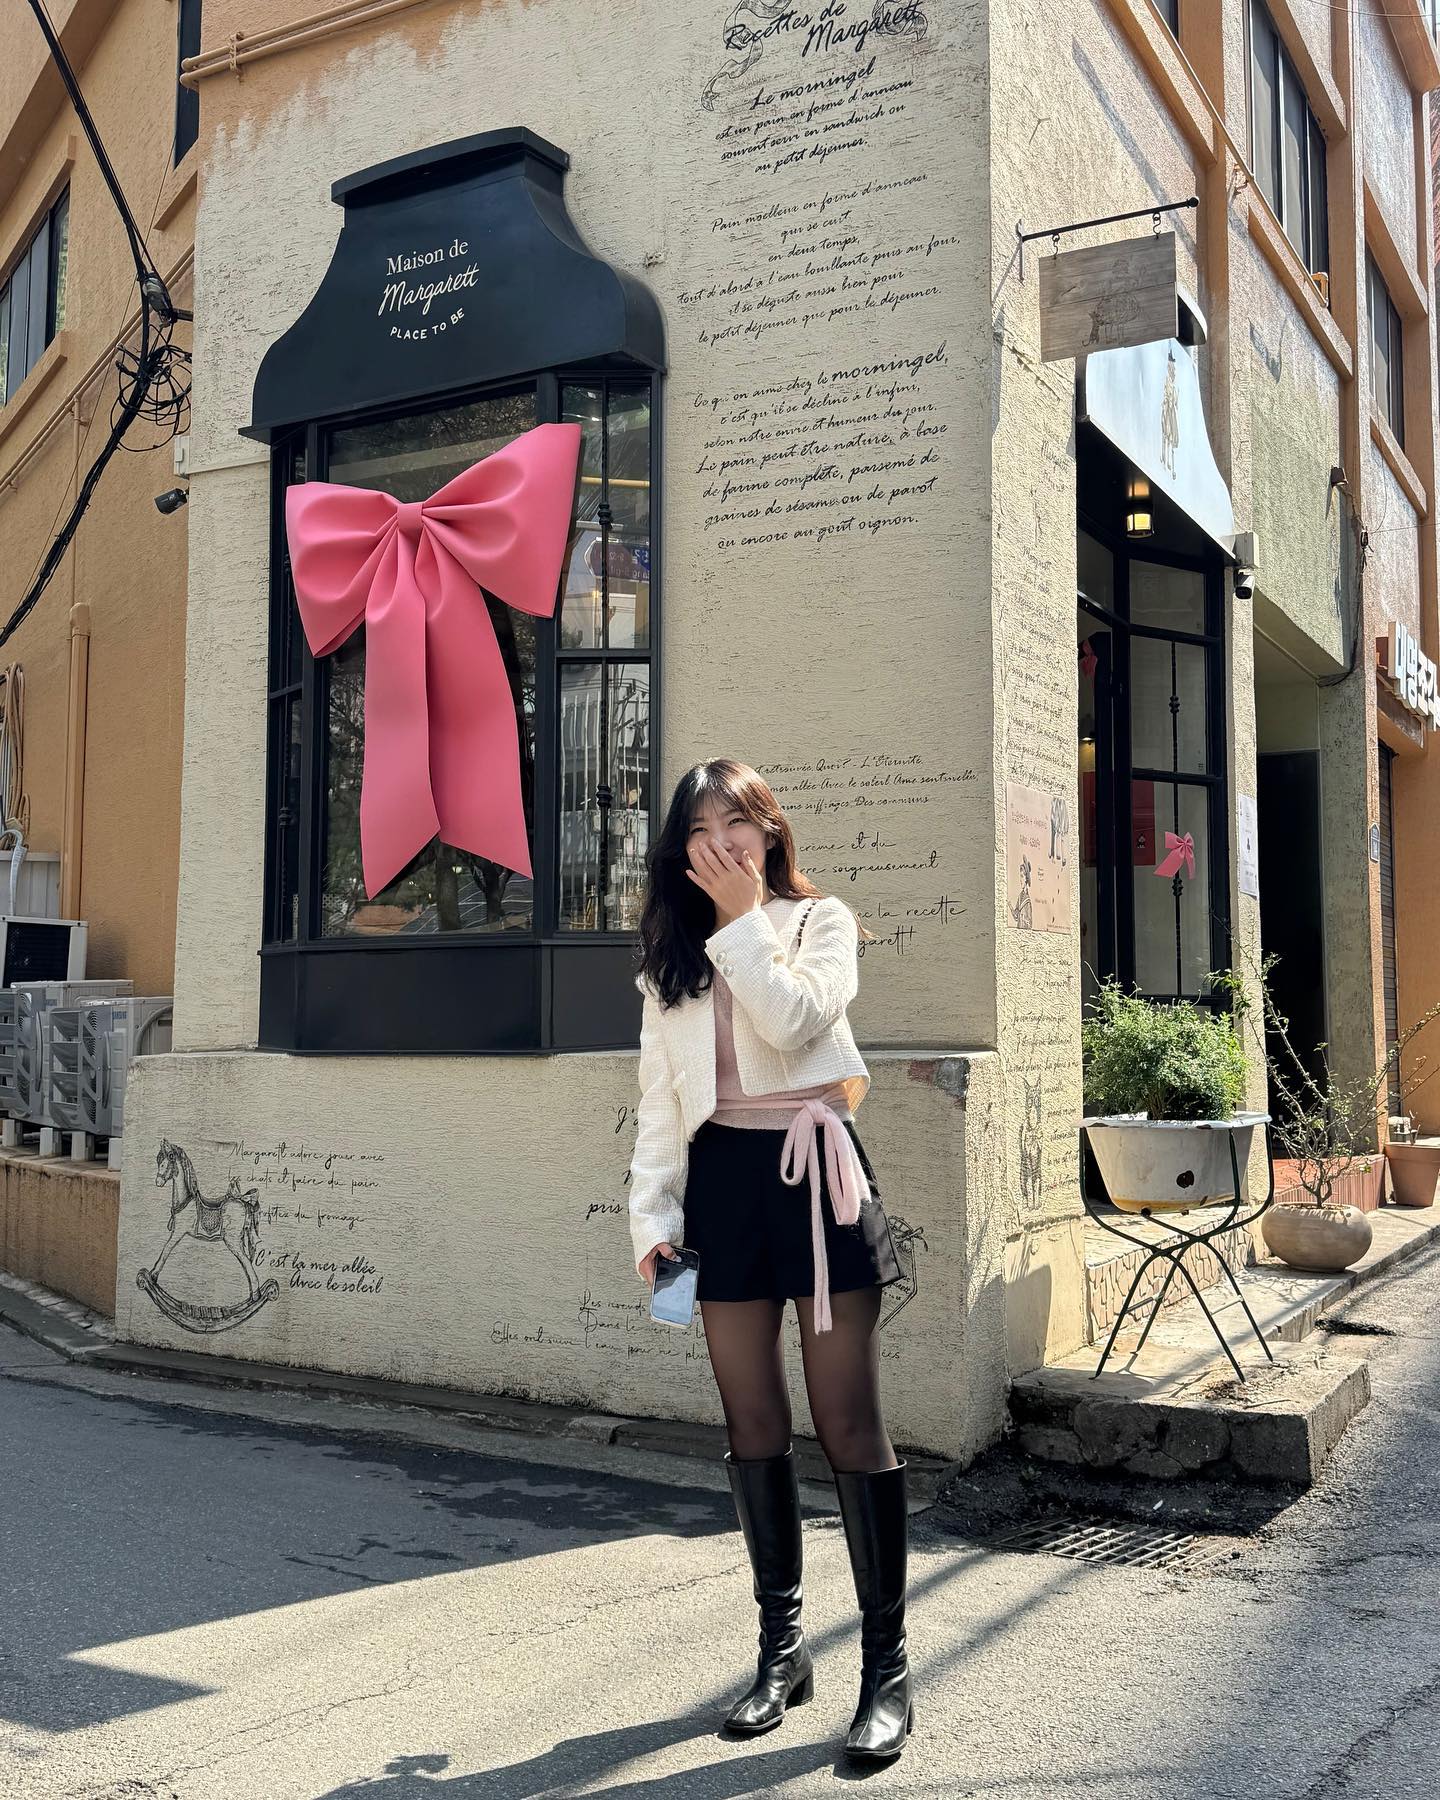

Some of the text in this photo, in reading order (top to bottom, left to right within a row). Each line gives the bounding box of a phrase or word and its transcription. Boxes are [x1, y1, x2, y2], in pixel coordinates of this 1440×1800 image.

[725, 0, 847, 50] Recettes de
[802, 1, 922, 57] Margarett
[750, 56, 876, 110] Le morningel
[754, 115, 785, 135] pain
[790, 110, 805, 121] en
[807, 99, 845, 122] forme
[804, 128, 820, 139] en
[823, 105, 885, 134] sandwich
[773, 150, 805, 173] petit
[711, 217, 741, 233] Pain
[386, 239, 469, 276] Maison de
[378, 262, 480, 316] Margarett
[390, 307, 465, 340] PLACE TO BE
[696, 455, 717, 473] Le
[719, 457, 756, 476] pain
[917, 419, 948, 437] base
[920, 447, 940, 465] de
[851, 831, 870, 849] et
[871, 831, 896, 853] du
[832, 850, 942, 882] soigneusement
[878, 902, 900, 919] la
[906, 895, 967, 925] recette
[857, 925, 917, 957] garett!
[586, 1199, 623, 1220] pris
[255, 1249, 290, 1268] C'est
